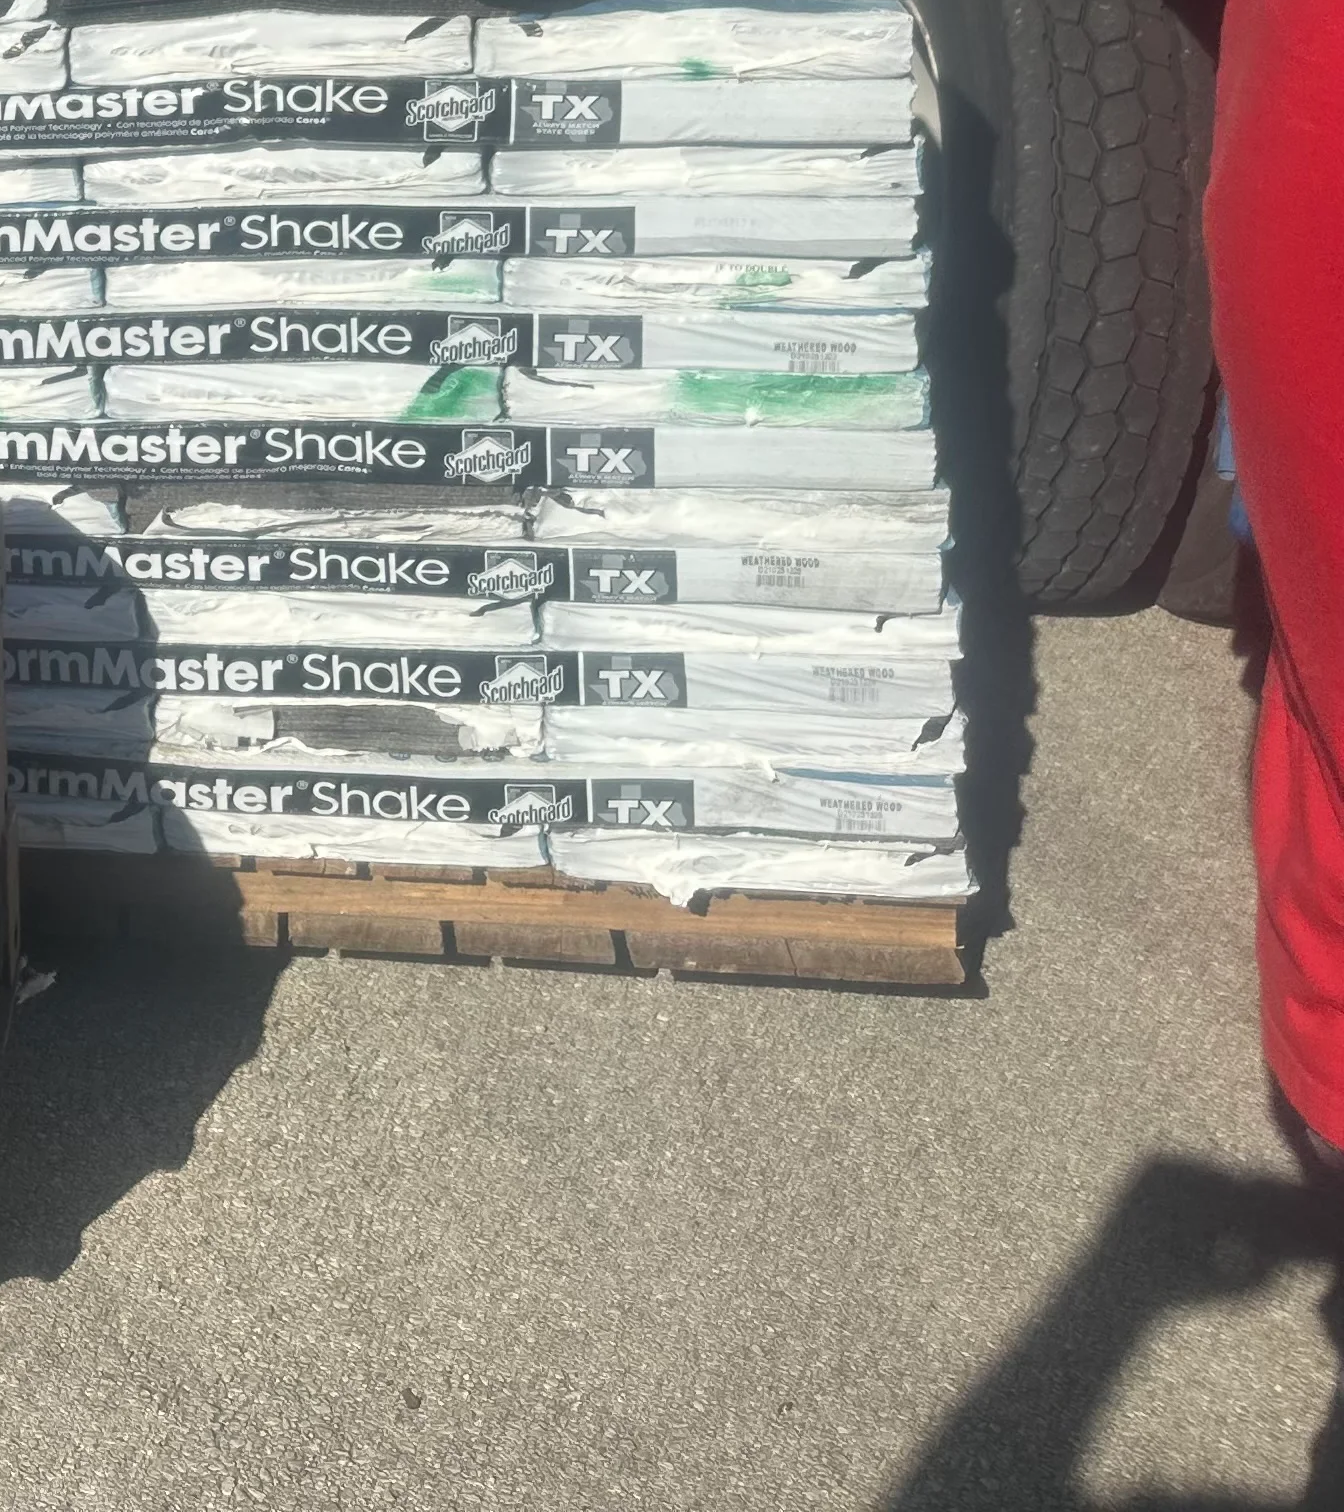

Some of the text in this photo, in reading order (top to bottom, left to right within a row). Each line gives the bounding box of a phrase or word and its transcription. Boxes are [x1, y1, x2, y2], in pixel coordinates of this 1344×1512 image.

[223, 79, 389, 114] Shake
[406, 88, 496, 126] Scotchgard
[532, 95, 600, 120] TX
[10, 125, 46, 134] Polymer
[48, 123, 102, 133] Technology
[240, 213, 404, 250] Shake
[421, 223, 511, 255] Scotchgard
[545, 229, 613, 253] TX
[249, 316, 412, 355] Shake
[430, 327, 518, 364] Scotchgard
[554, 335, 622, 362] TX
[774, 342, 857, 354] WEATHERED WOOD
[265, 427, 427, 469] Shake
[444, 441, 531, 478] Scotchgard
[566, 448, 633, 473] TX
[289, 547, 450, 586] Shake
[741, 555, 820, 568] WEATHERED WOOD
[467, 563, 554, 596] Scotchgard
[589, 569, 657, 595] TX
[302, 653, 462, 698] Shake
[479, 665, 564, 704] Scotchgard
[599, 669, 667, 699] TX
[812, 666, 895, 678] WEATHERED WOOD
[311, 781, 471, 822] Shake
[607, 799, 675, 826] TX
[820, 798, 903, 812] WEATHERED WOOD
